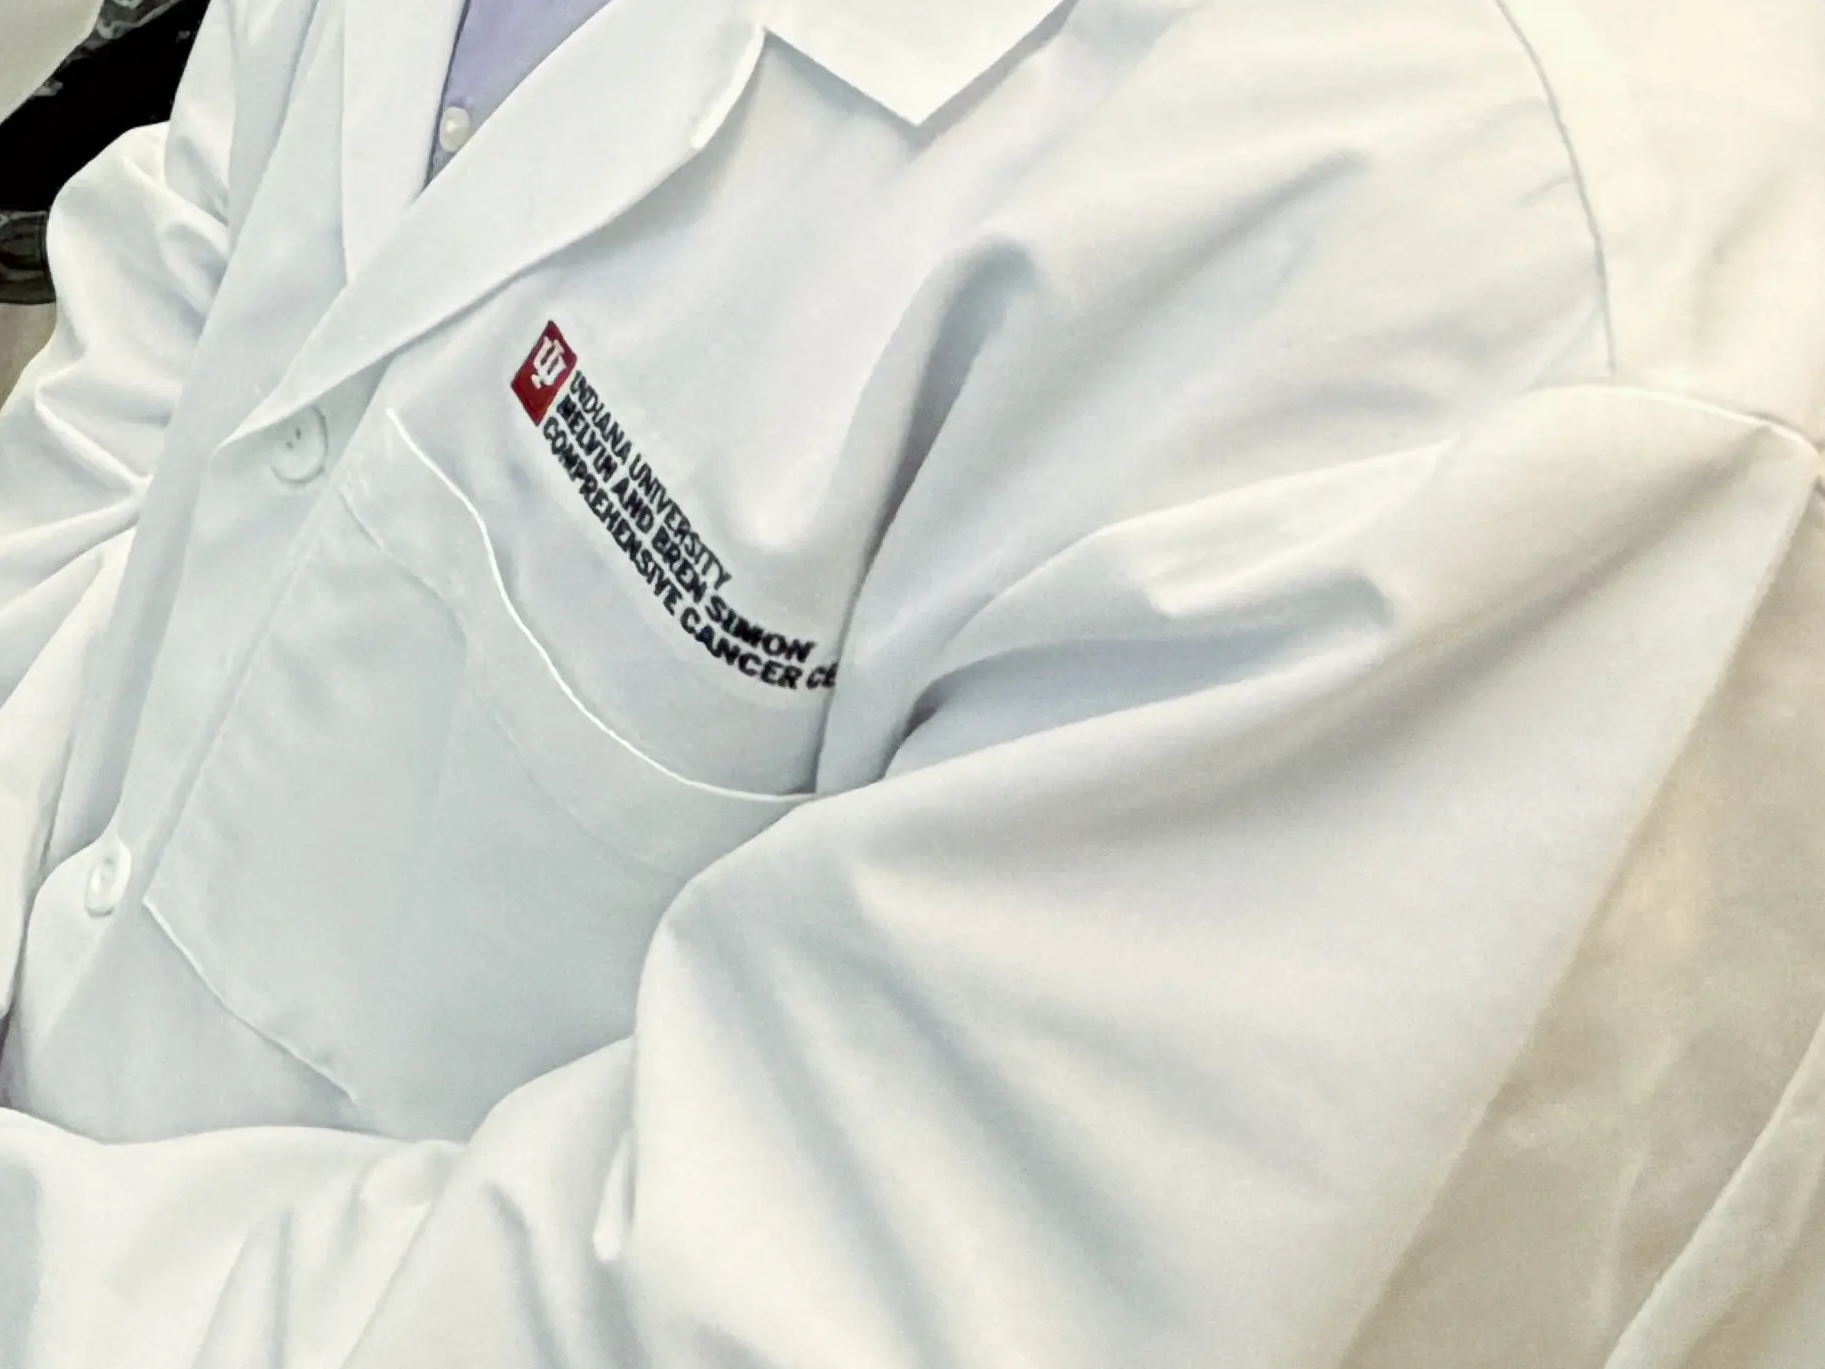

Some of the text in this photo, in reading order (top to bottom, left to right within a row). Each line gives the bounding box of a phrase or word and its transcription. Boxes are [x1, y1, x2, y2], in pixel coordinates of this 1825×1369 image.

[543, 417, 683, 616] COMPREHENSIVE
[680, 607, 802, 690] CANCER
[557, 393, 817, 664] MELVIN AND BREN SIMON
[570, 370, 732, 591] INDIANA UNIVERSITY
